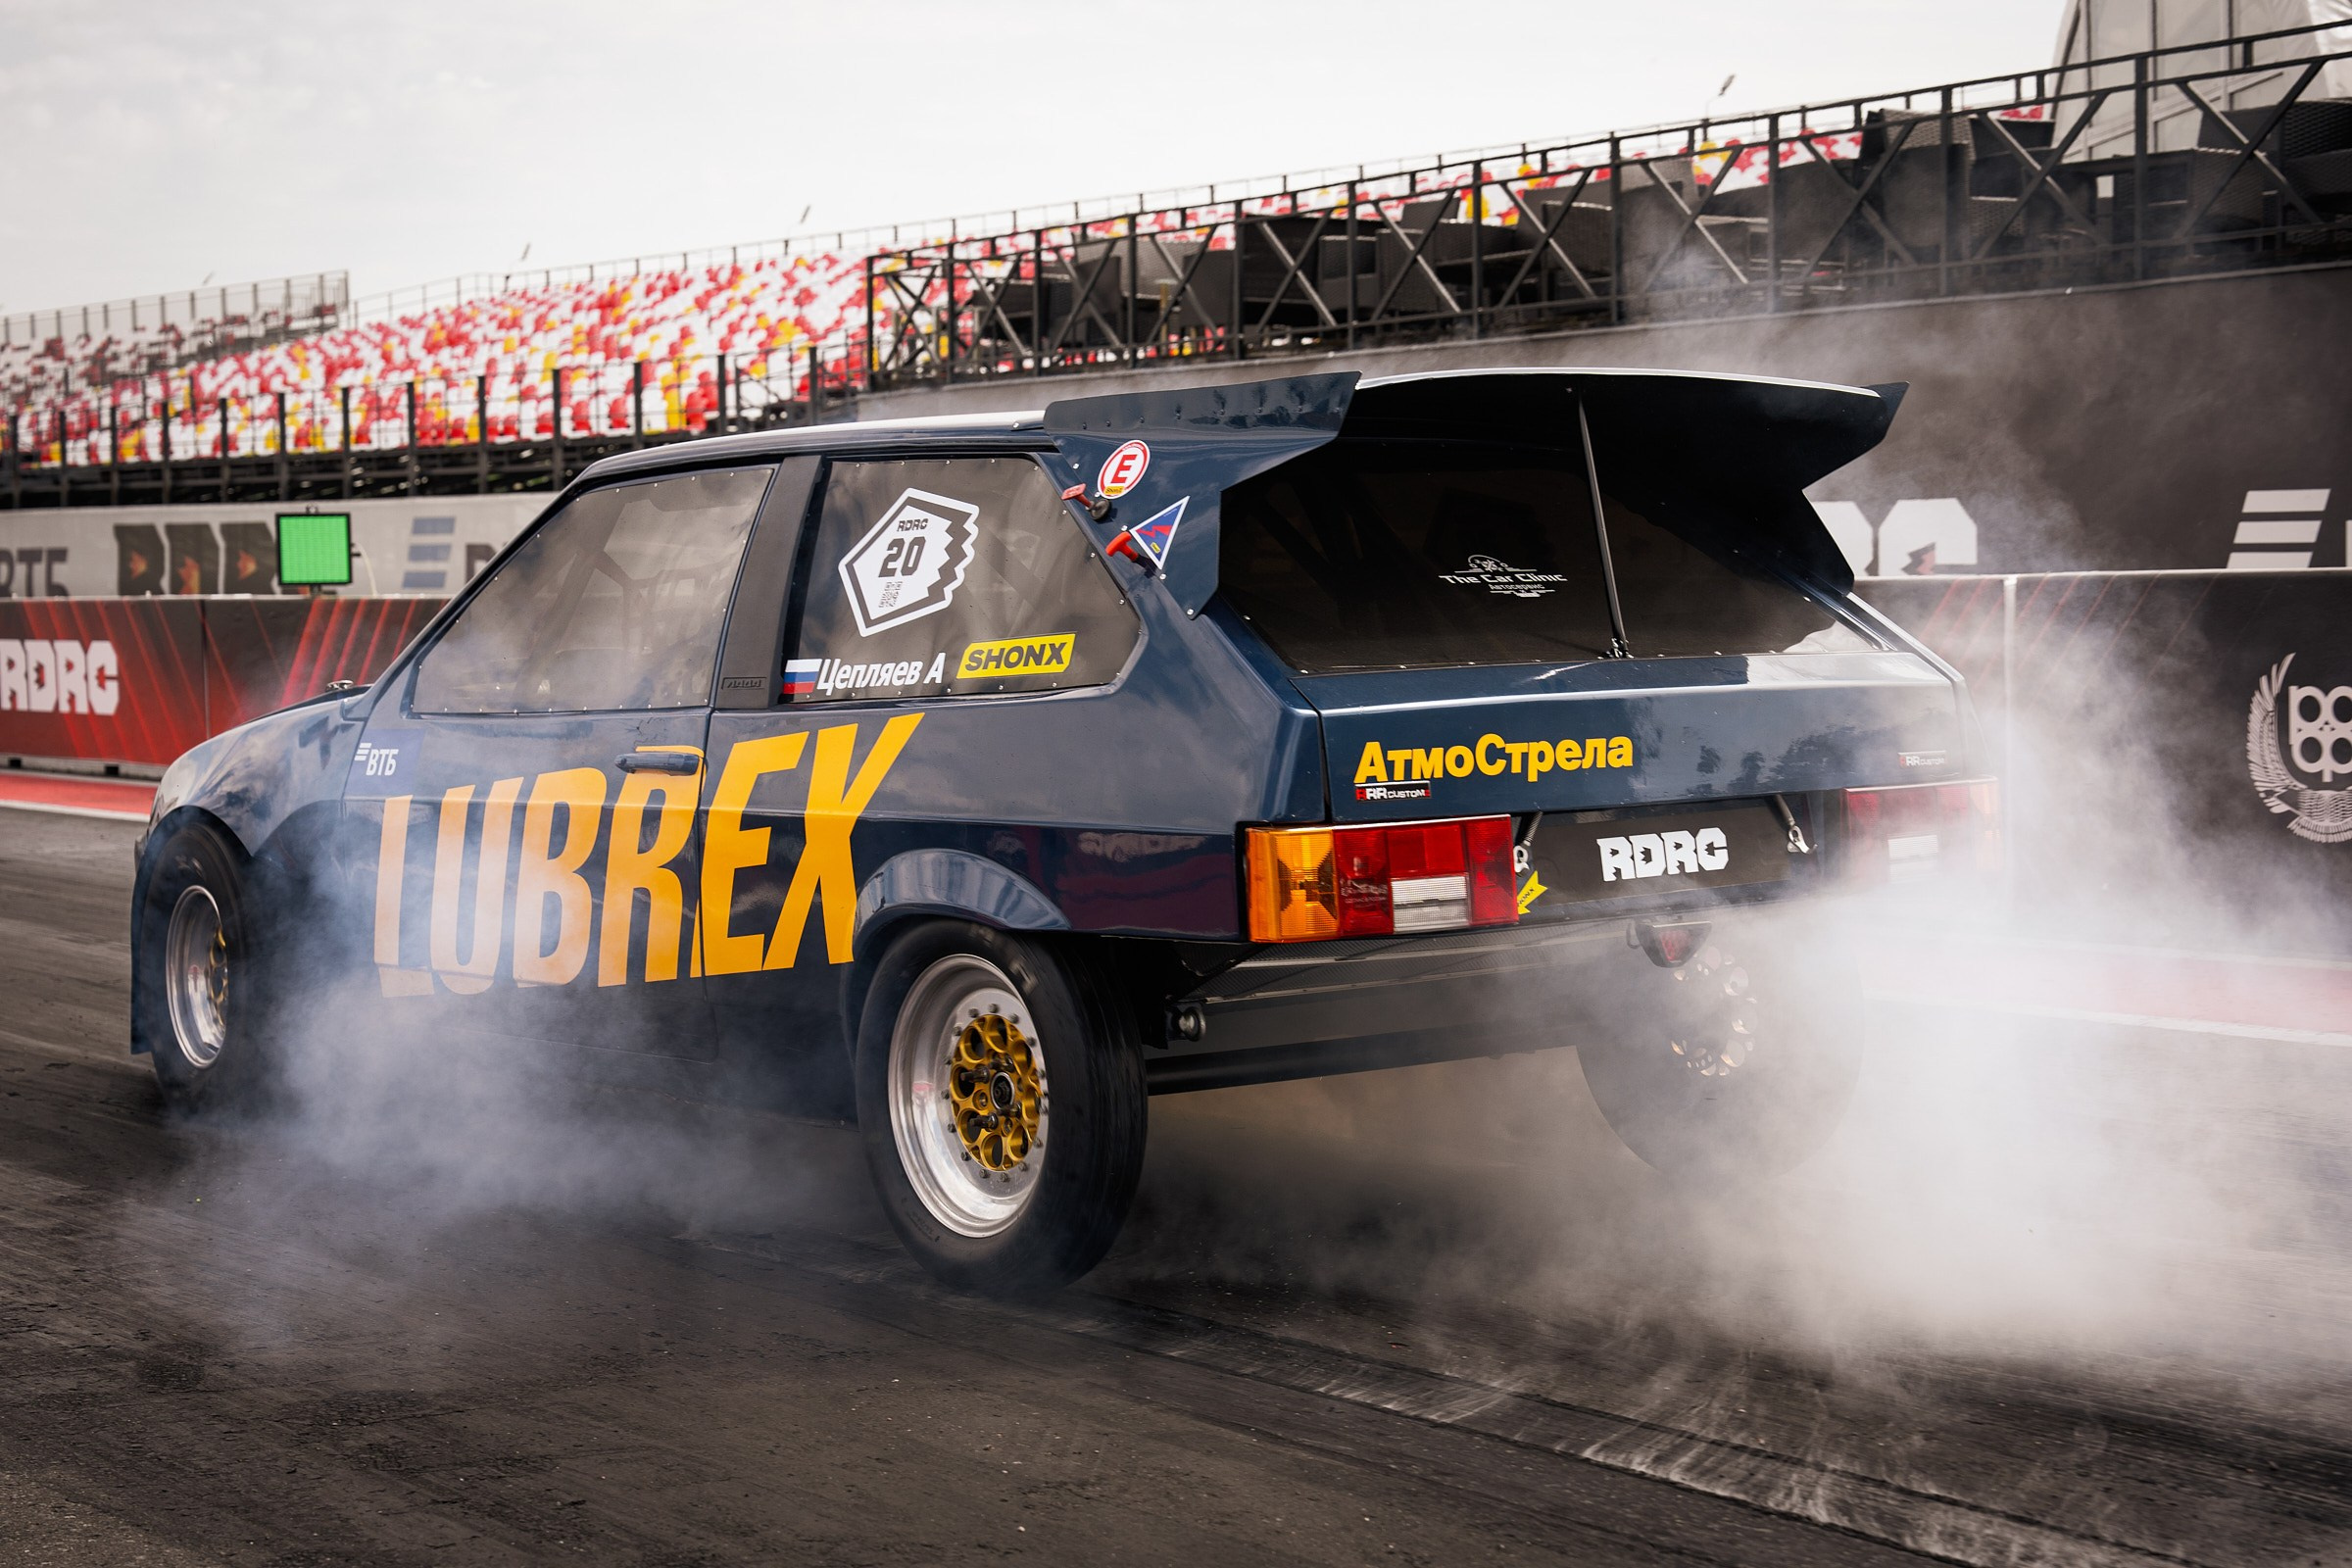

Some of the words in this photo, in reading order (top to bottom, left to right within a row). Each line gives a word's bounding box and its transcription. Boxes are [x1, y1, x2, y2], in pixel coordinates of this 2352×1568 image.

[1110, 454, 1138, 483] E
[897, 517, 928, 532] RDRC
[114, 522, 278, 596] RDR
[878, 536, 926, 577] 20
[1438, 574, 1482, 584] The
[1480, 574, 1514, 583] Car
[1514, 573, 1568, 582] Clinic
[816, 658, 924, 695] Цепляев
[964, 642, 1067, 672] SHONX
[0, 639, 120, 715] RDRC
[366, 748, 400, 776] ВТБ
[1353, 733, 1634, 783] АтмоСтрела
[373, 711, 925, 998] LUBREX
[1596, 827, 1729, 882] RDRC
